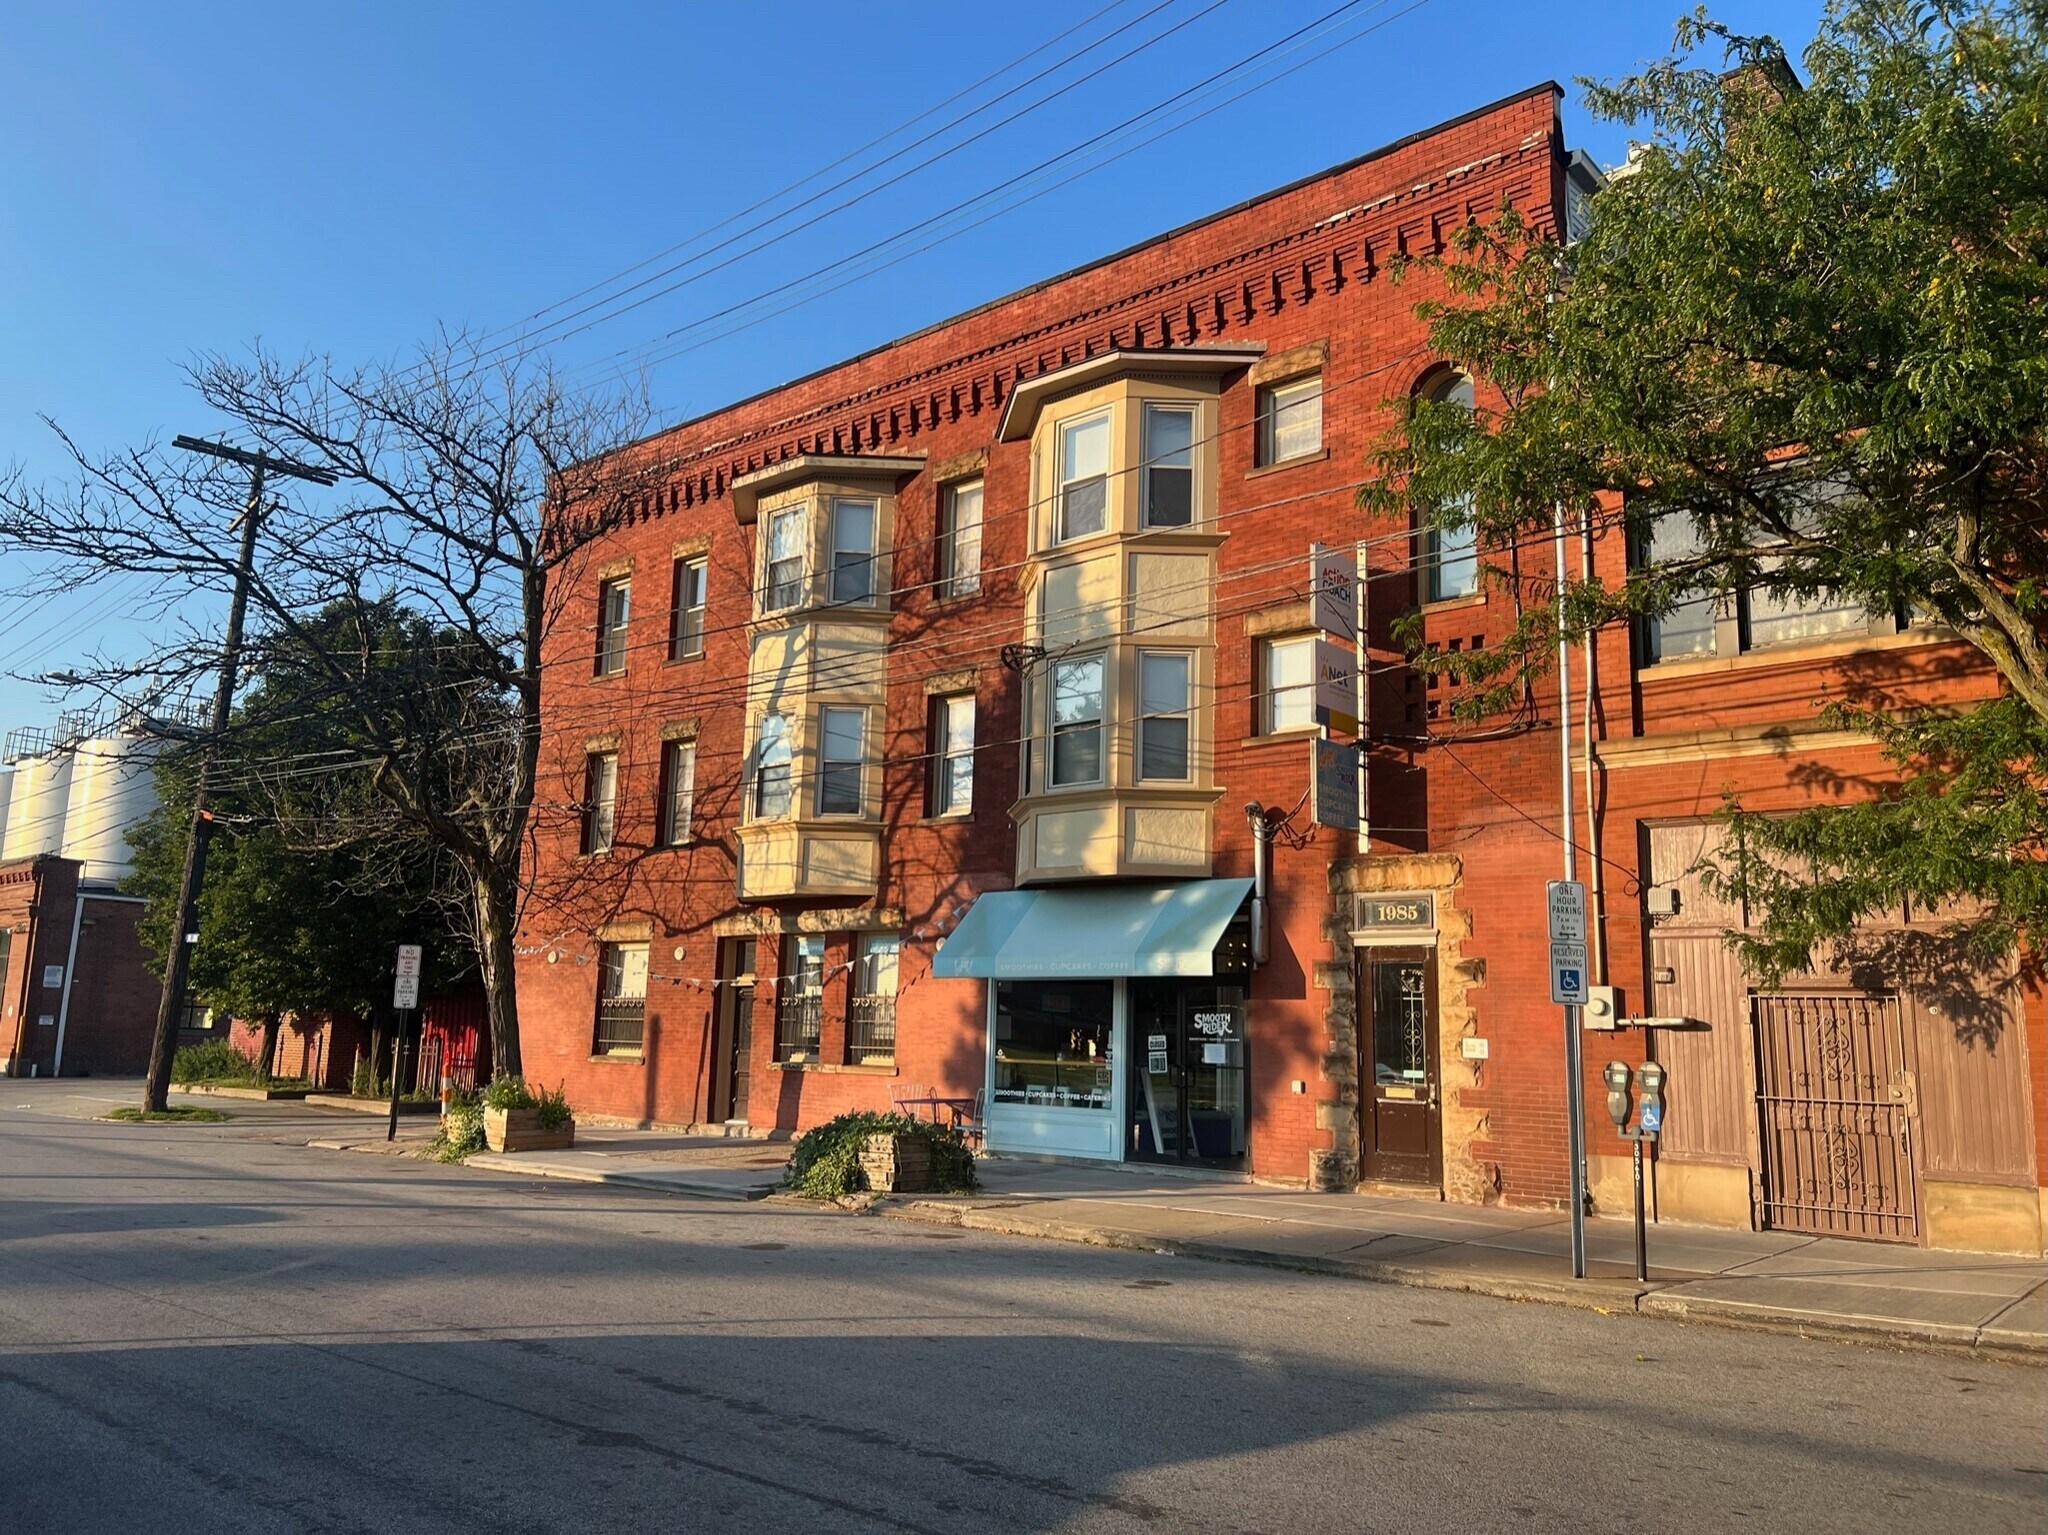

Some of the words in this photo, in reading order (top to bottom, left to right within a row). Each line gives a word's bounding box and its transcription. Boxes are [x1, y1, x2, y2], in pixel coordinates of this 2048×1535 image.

[1322, 580, 1351, 604] COACH
[1320, 663, 1348, 687] ANet
[1319, 797, 1354, 815] CUPCAKES
[1319, 811, 1345, 825] COFFEE
[1559, 886, 1573, 896] ONE
[1556, 896, 1577, 905] HOUR
[1378, 905, 1418, 921] 1985
[1552, 906, 1582, 916] PARKING
[1553, 947, 1584, 958] RESERVED
[1000, 963, 1043, 971] SMOOTHIES
[1050, 962, 1091, 970] CUPCAKES
[1099, 962, 1129, 970] COFFEE
[1555, 958, 1583, 968] PARKING
[1194, 1013, 1231, 1029] SMOOTH
[1202, 1021, 1233, 1036] RIDER
[995, 1090, 1025, 1098] SMOOTHIES
[1028, 1091, 1057, 1099] CUPCAKES
[1059, 1093, 1081, 1101] COFFEE
[1083, 1094, 1112, 1102] CATERING
